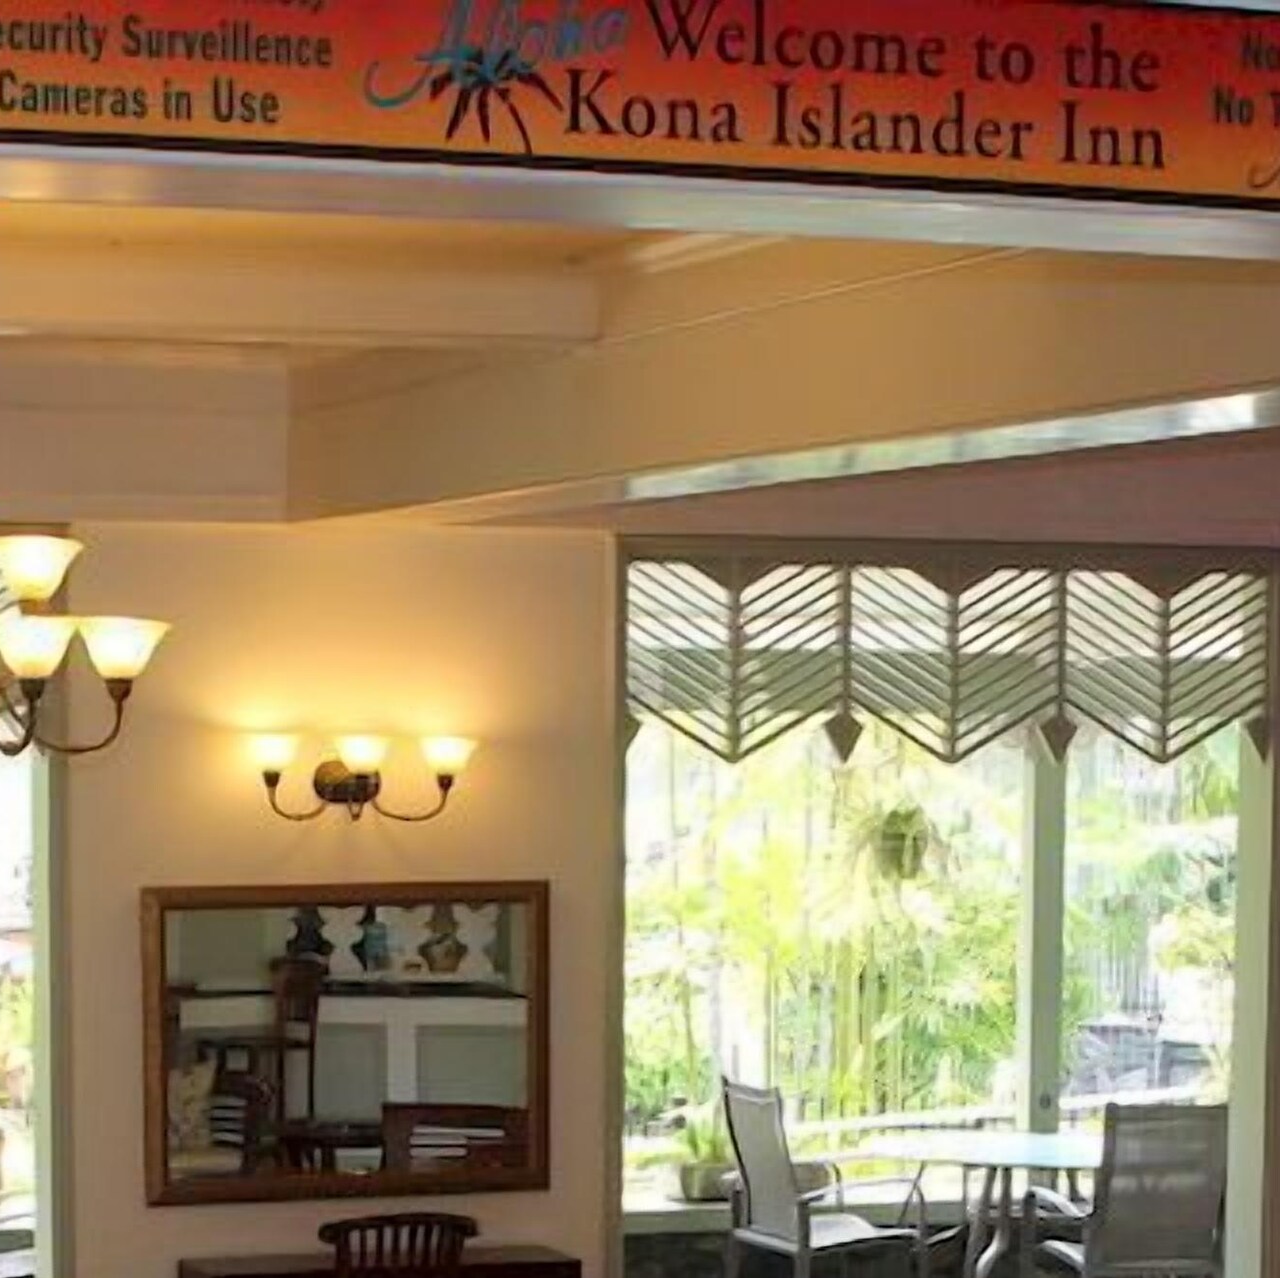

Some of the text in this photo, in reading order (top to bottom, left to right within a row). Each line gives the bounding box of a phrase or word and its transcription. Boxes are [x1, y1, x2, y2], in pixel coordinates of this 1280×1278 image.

[122, 14, 332, 67] Surveillence
[644, 0, 1160, 92] Welcome to the
[164, 79, 192, 121] in
[213, 77, 280, 123] Use
[564, 69, 1164, 168] Kona Islander Inn
[1213, 86, 1254, 124] No
